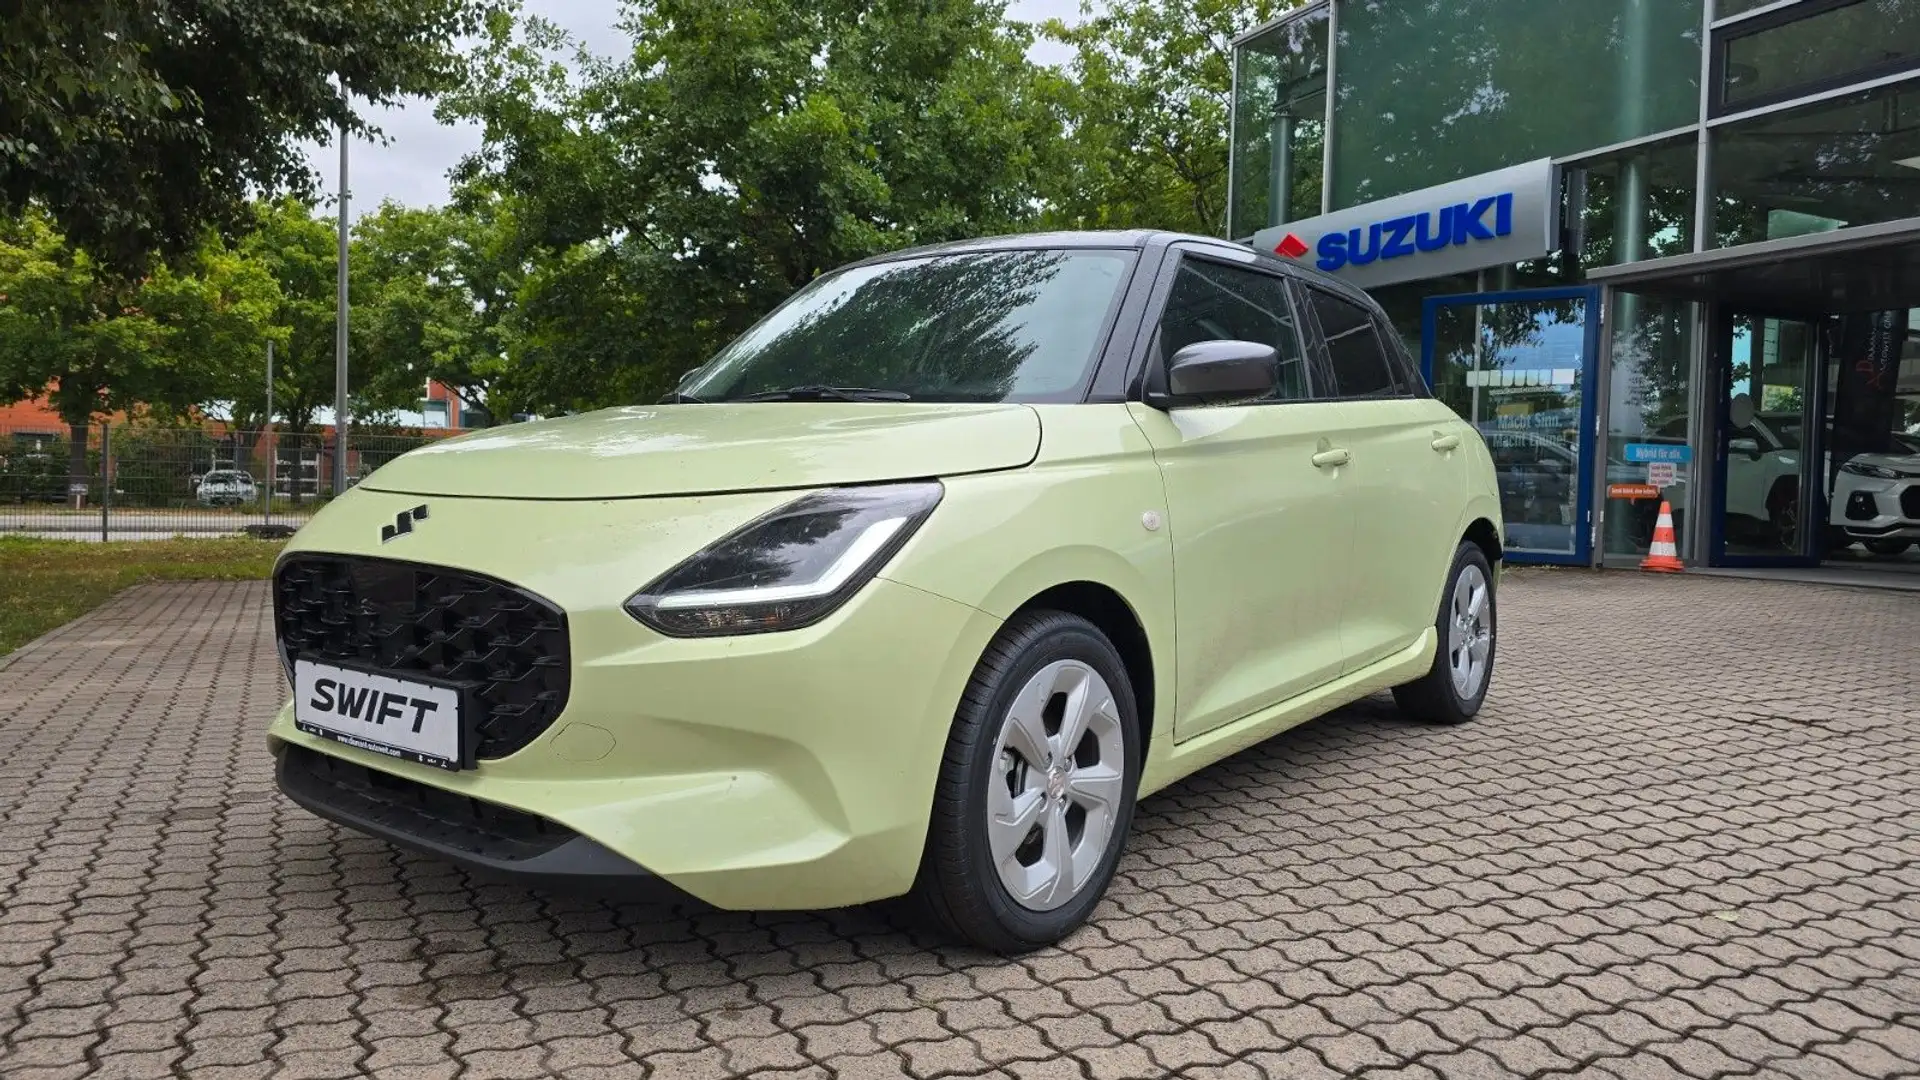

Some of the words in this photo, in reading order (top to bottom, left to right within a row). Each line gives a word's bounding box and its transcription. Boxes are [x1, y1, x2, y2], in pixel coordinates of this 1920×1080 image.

[1316, 192, 1513, 272] SUZUKI
[1498, 414, 1531, 429] Macht
[1493, 432, 1526, 447] Macht
[310, 678, 439, 734] SWIFT
